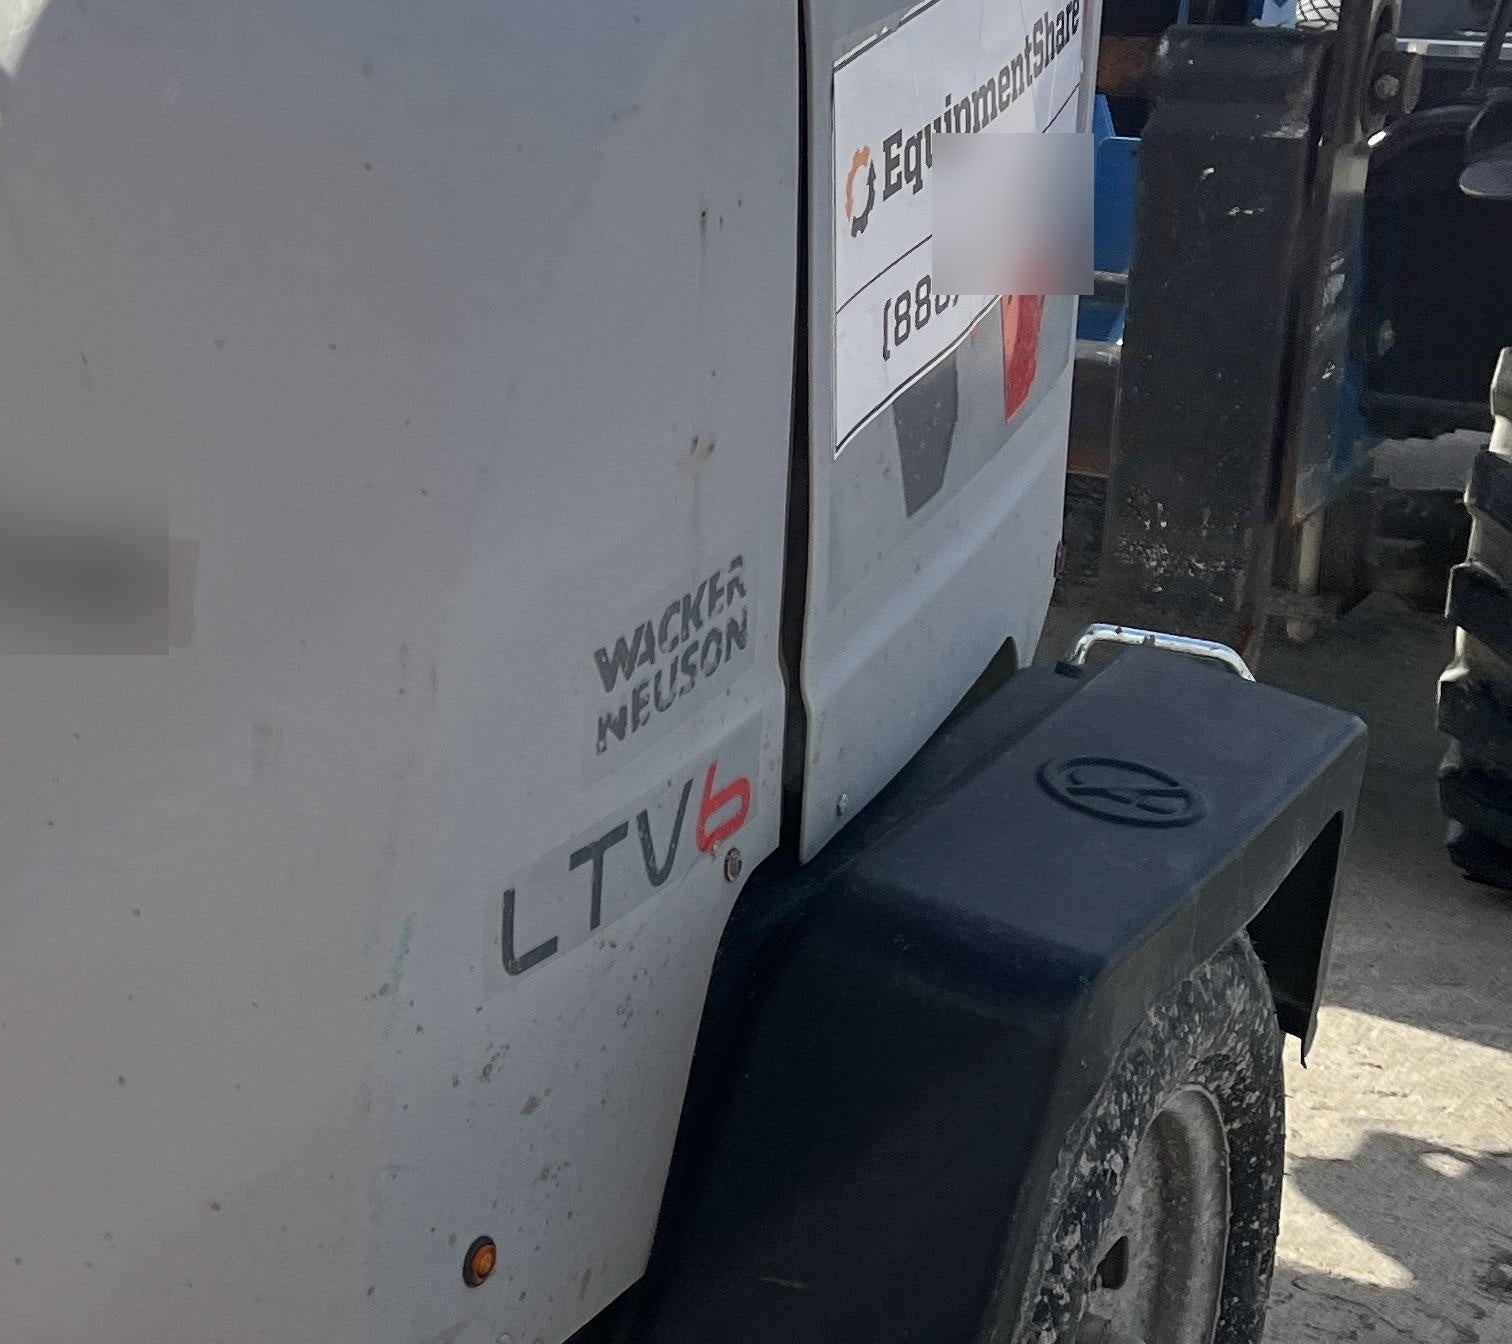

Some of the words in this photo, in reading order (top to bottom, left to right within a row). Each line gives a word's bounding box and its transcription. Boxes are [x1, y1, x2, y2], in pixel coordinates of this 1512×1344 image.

[594, 555, 747, 692] WACKER
[595, 605, 748, 756] NEUSON
[501, 759, 752, 976] LTV6
